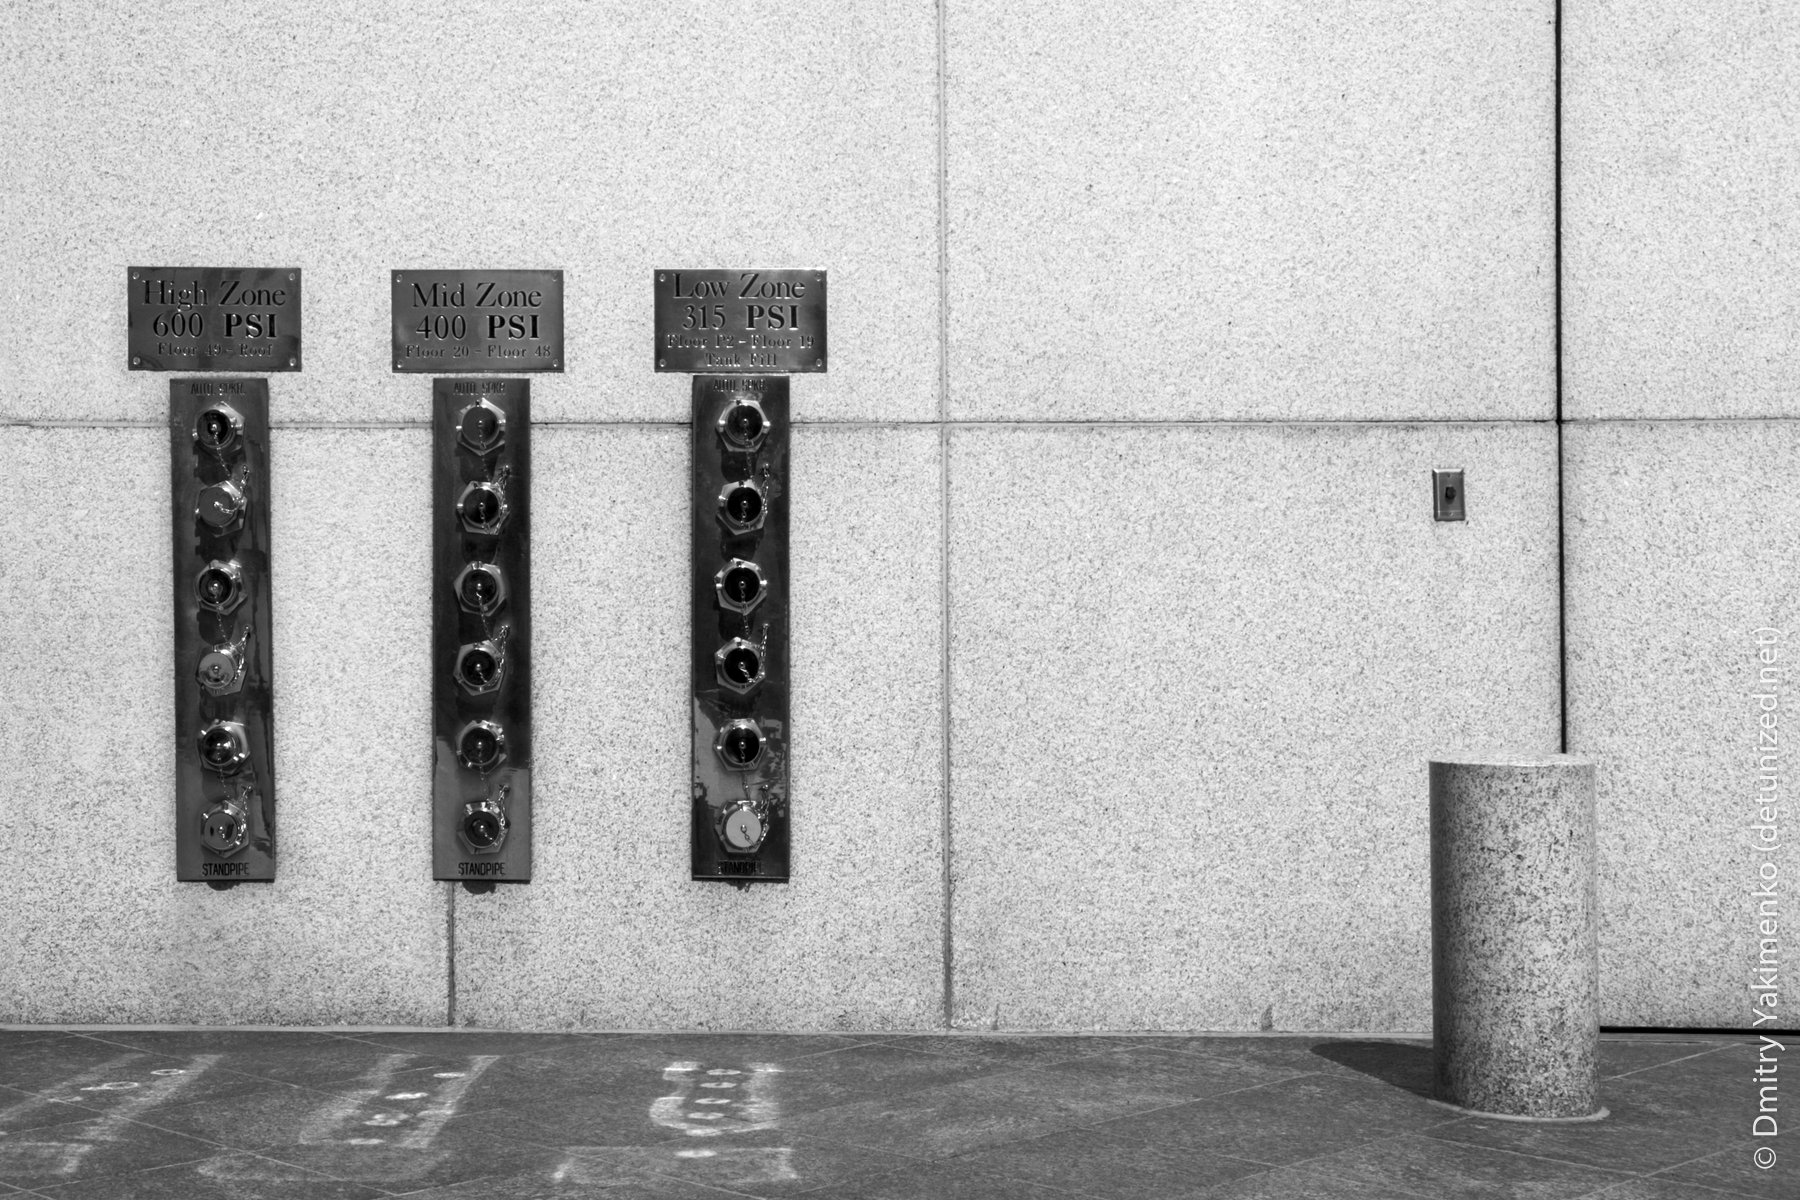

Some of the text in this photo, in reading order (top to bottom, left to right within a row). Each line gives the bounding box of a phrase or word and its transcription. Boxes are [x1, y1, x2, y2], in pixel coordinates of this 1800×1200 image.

[142, 280, 286, 311] High Zone
[411, 282, 542, 308] Mid Zone
[673, 273, 806, 299] Low Zone
[153, 312, 277, 338] 600 PSI
[415, 314, 540, 340] 400 PSI
[682, 305, 799, 331] 315 PSI
[157, 342, 197, 357] Floor
[239, 343, 273, 357] Roof
[405, 344, 445, 358] Floor
[453, 345, 469, 358] 20
[487, 344, 527, 358] Floor
[534, 345, 551, 359] 48
[667, 334, 708, 348] Floor
[751, 334, 791, 349] Floor
[800, 335, 815, 349] 19
[705, 353, 777, 367] Tank Fill
[202, 862, 250, 876] STANDPIPE
[458, 862, 506, 876] STANDPIPE
